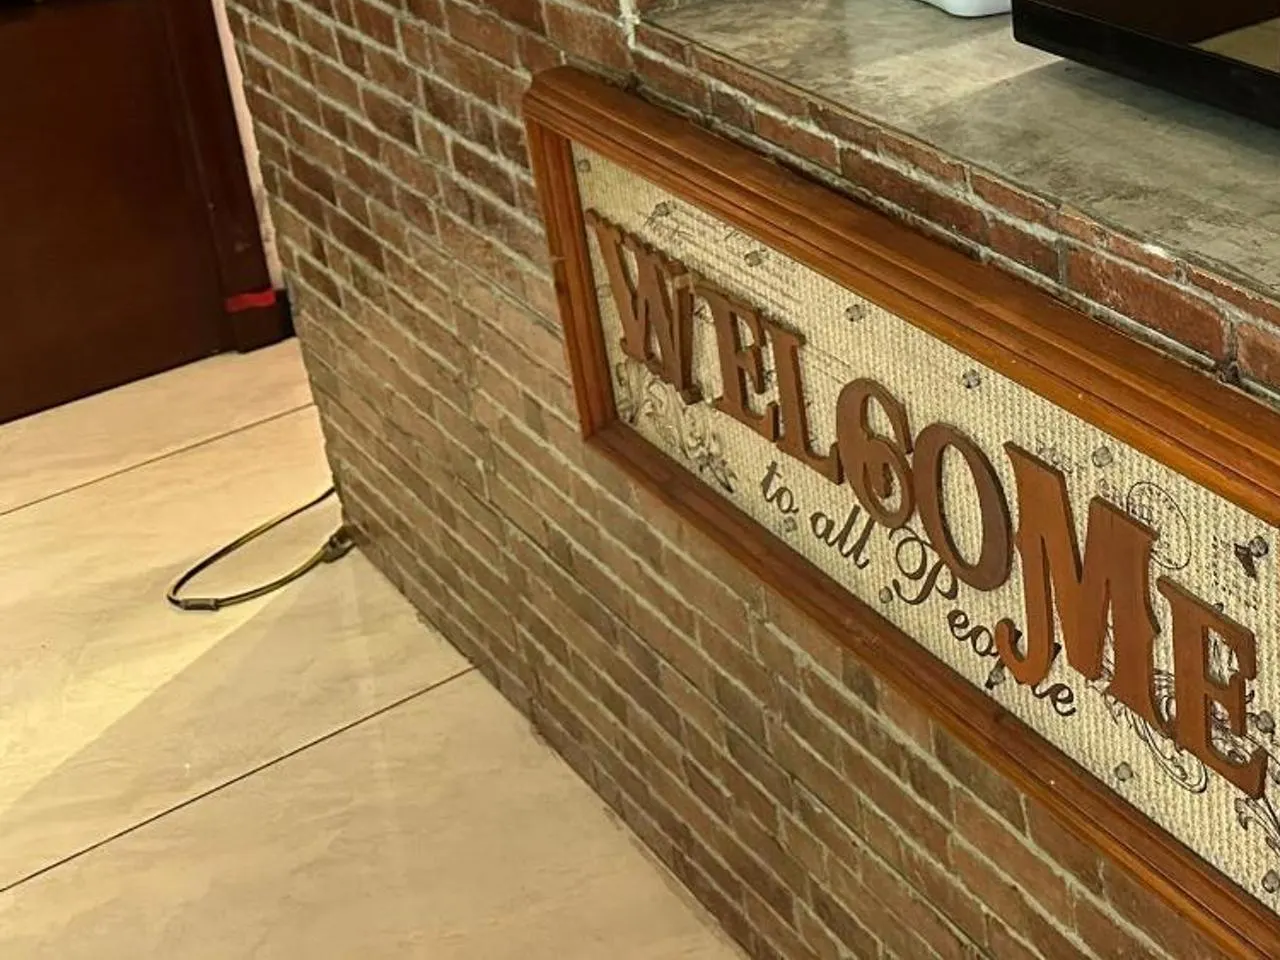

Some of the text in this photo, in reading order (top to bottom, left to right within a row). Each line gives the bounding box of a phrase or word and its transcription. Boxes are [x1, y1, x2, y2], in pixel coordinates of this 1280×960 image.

[585, 208, 1269, 803] WELCOME
[761, 460, 1077, 717] to all Peoe
